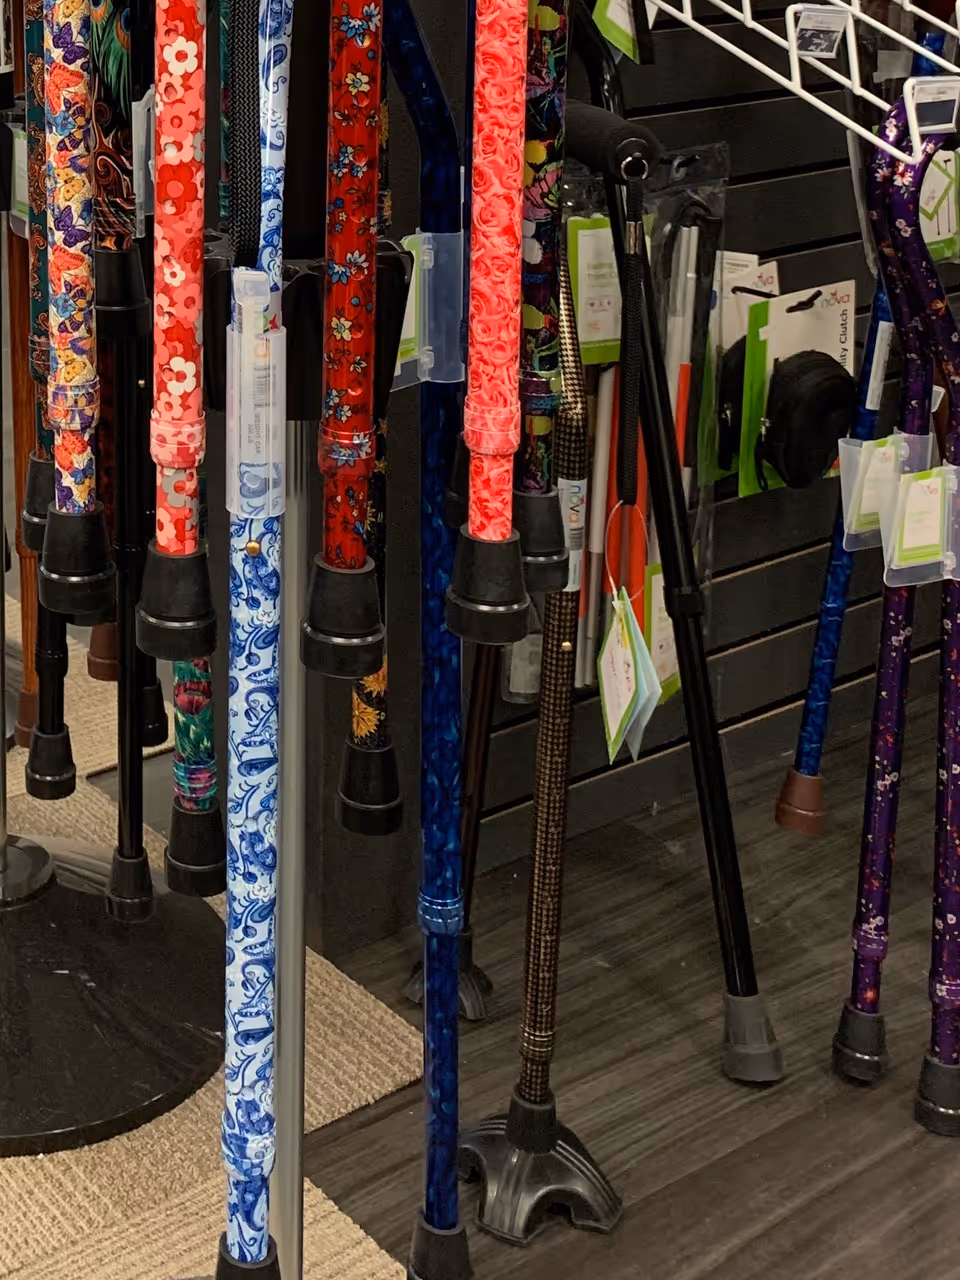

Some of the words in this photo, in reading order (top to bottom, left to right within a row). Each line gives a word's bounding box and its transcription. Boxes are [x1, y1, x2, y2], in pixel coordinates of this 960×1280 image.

[751, 274, 774, 289] nova
[820, 291, 851, 309] nova
[839, 308, 849, 345] Clutch
[569, 484, 581, 524] nova
